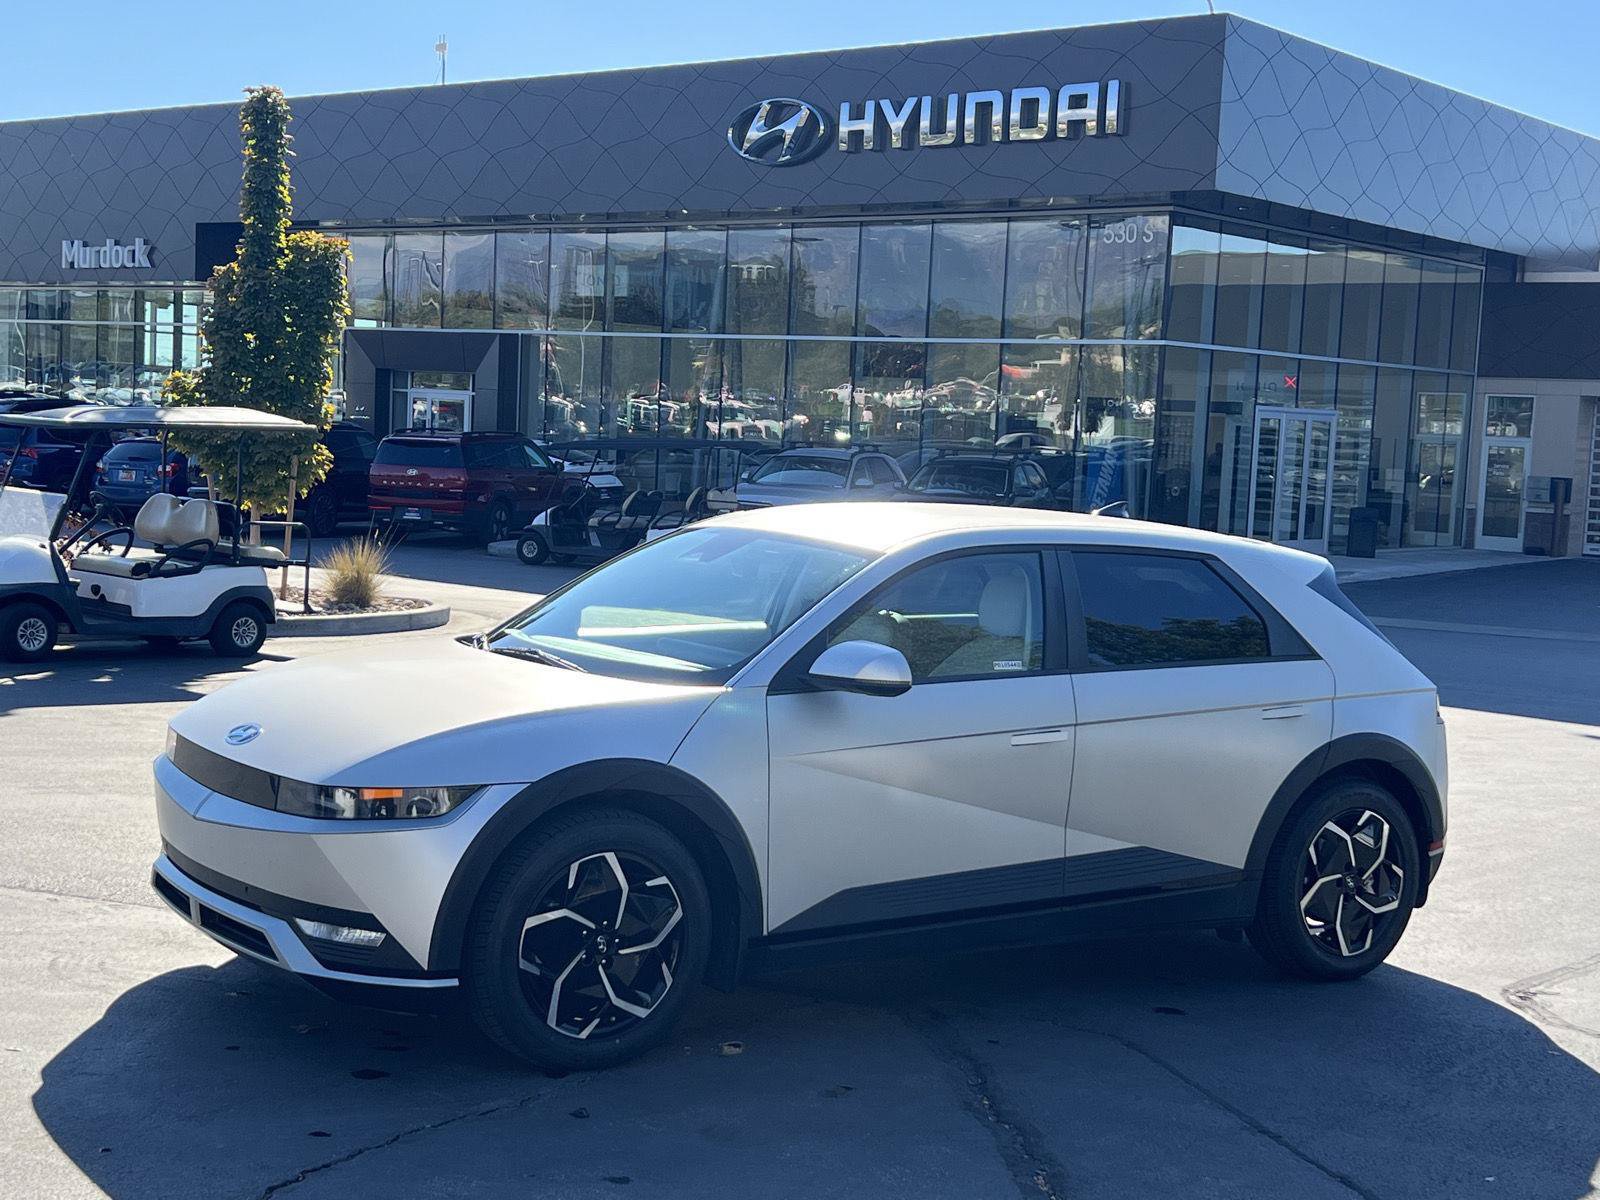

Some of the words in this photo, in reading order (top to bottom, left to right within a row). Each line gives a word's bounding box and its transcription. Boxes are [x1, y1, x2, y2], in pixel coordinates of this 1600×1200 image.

[839, 79, 1123, 151] HYUNDAI
[1103, 223, 1138, 244] 530
[1142, 223, 1154, 243] S
[61, 238, 152, 269] Murdock
